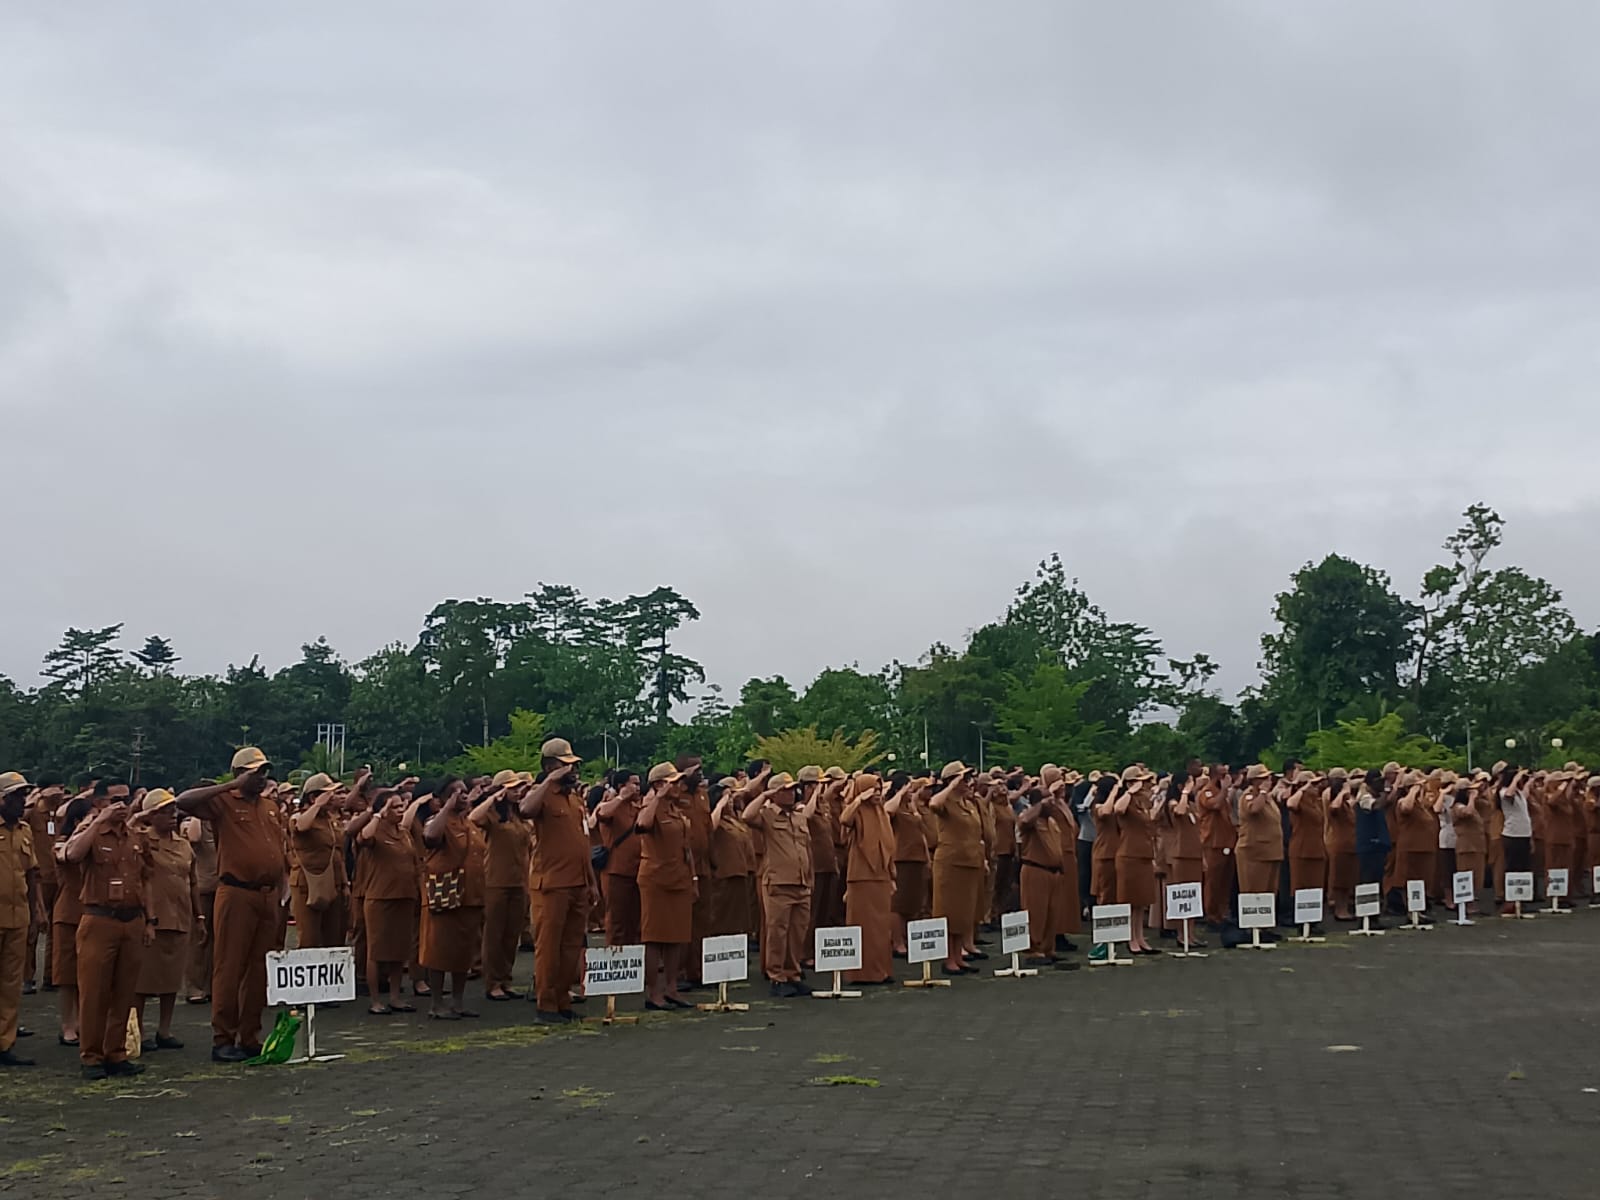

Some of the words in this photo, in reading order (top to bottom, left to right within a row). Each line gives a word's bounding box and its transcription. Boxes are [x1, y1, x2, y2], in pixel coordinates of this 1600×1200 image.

[630, 958, 642, 968] DAN
[277, 963, 345, 989] DISTRIK
[588, 970, 637, 983] PERLENGKAPAN
